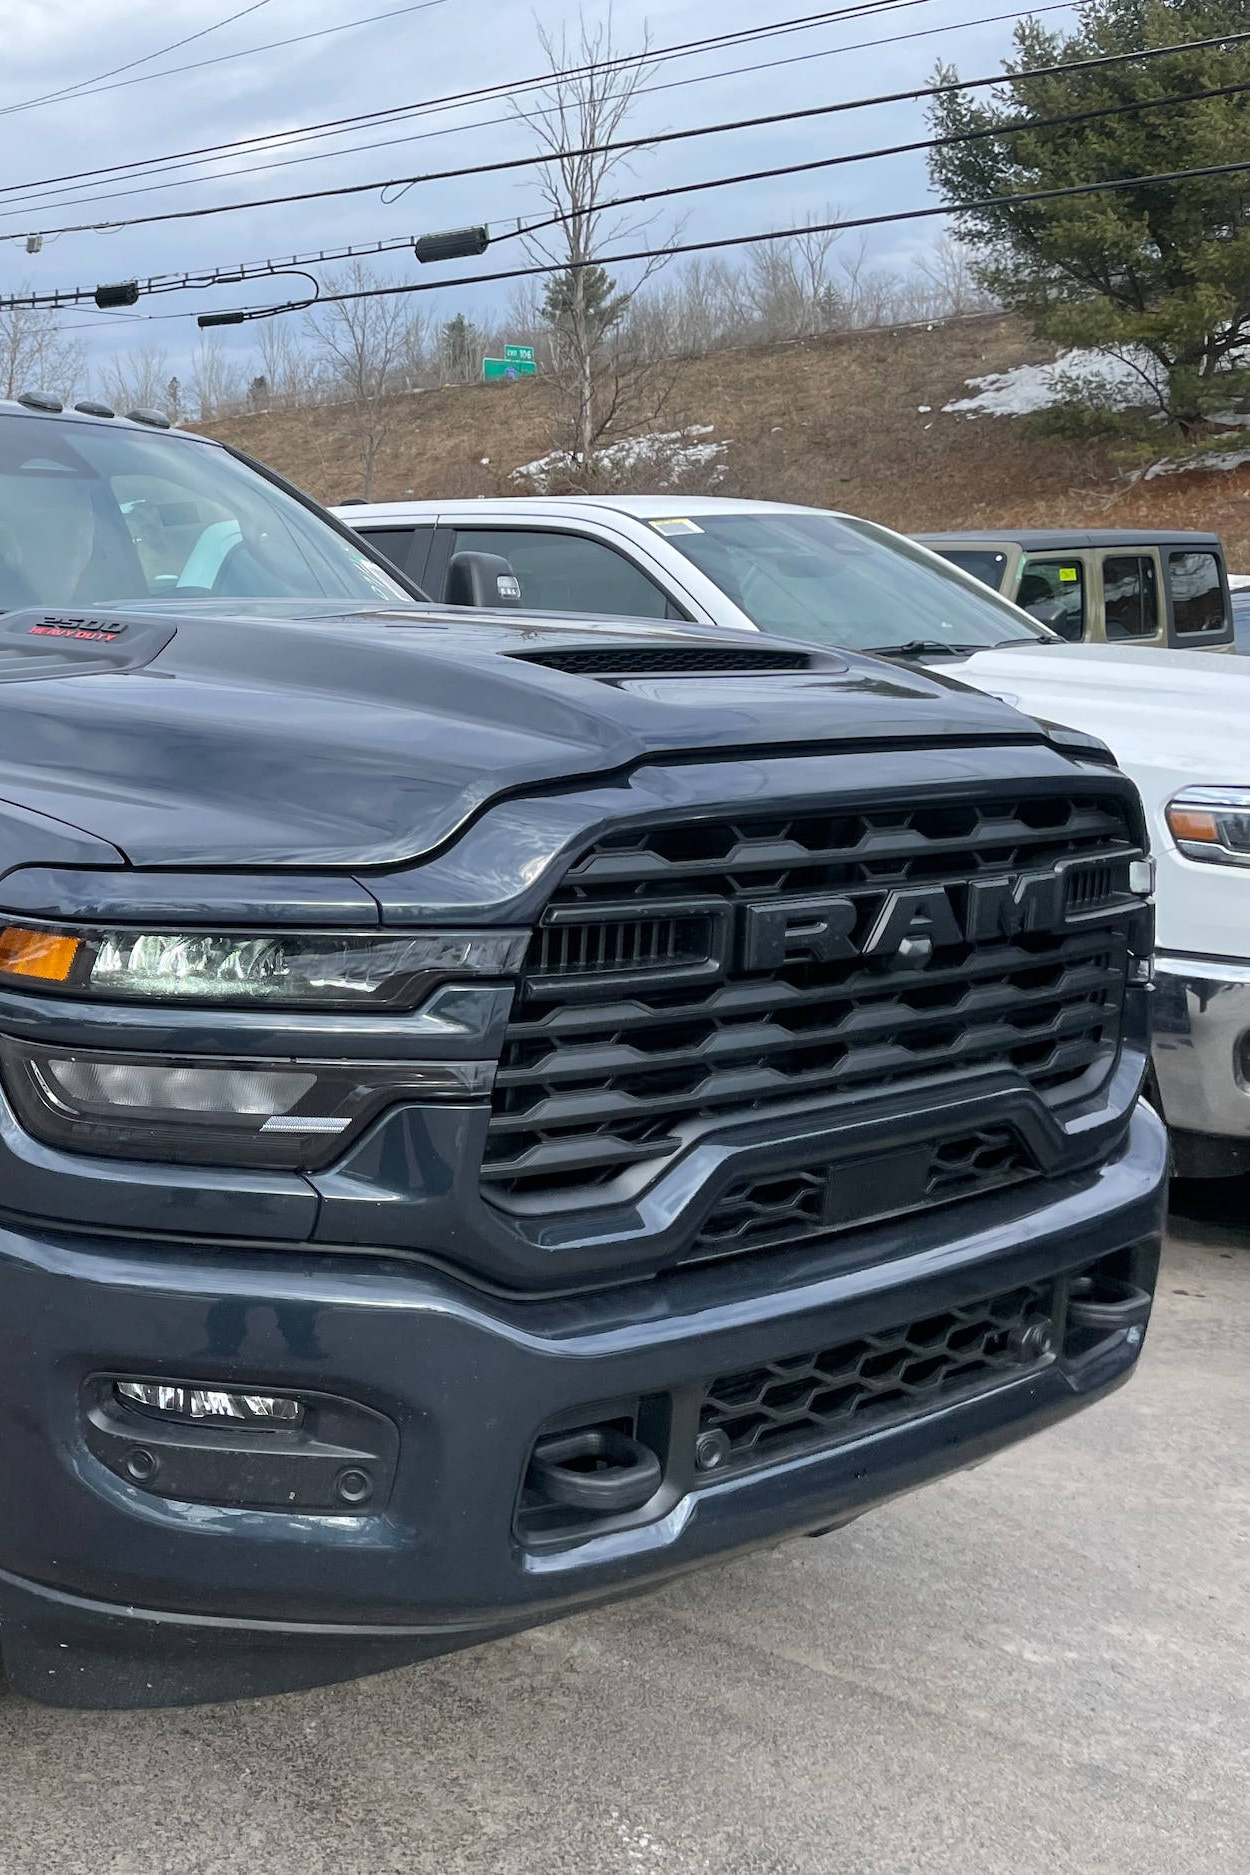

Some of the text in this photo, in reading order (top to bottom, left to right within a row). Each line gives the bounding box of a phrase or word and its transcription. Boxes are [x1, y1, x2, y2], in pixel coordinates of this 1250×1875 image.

[519, 350, 532, 359] 106
[36, 617, 128, 634] 2500
[29, 626, 118, 642] HEAVY DUTY
[745, 873, 1058, 970] RAM
